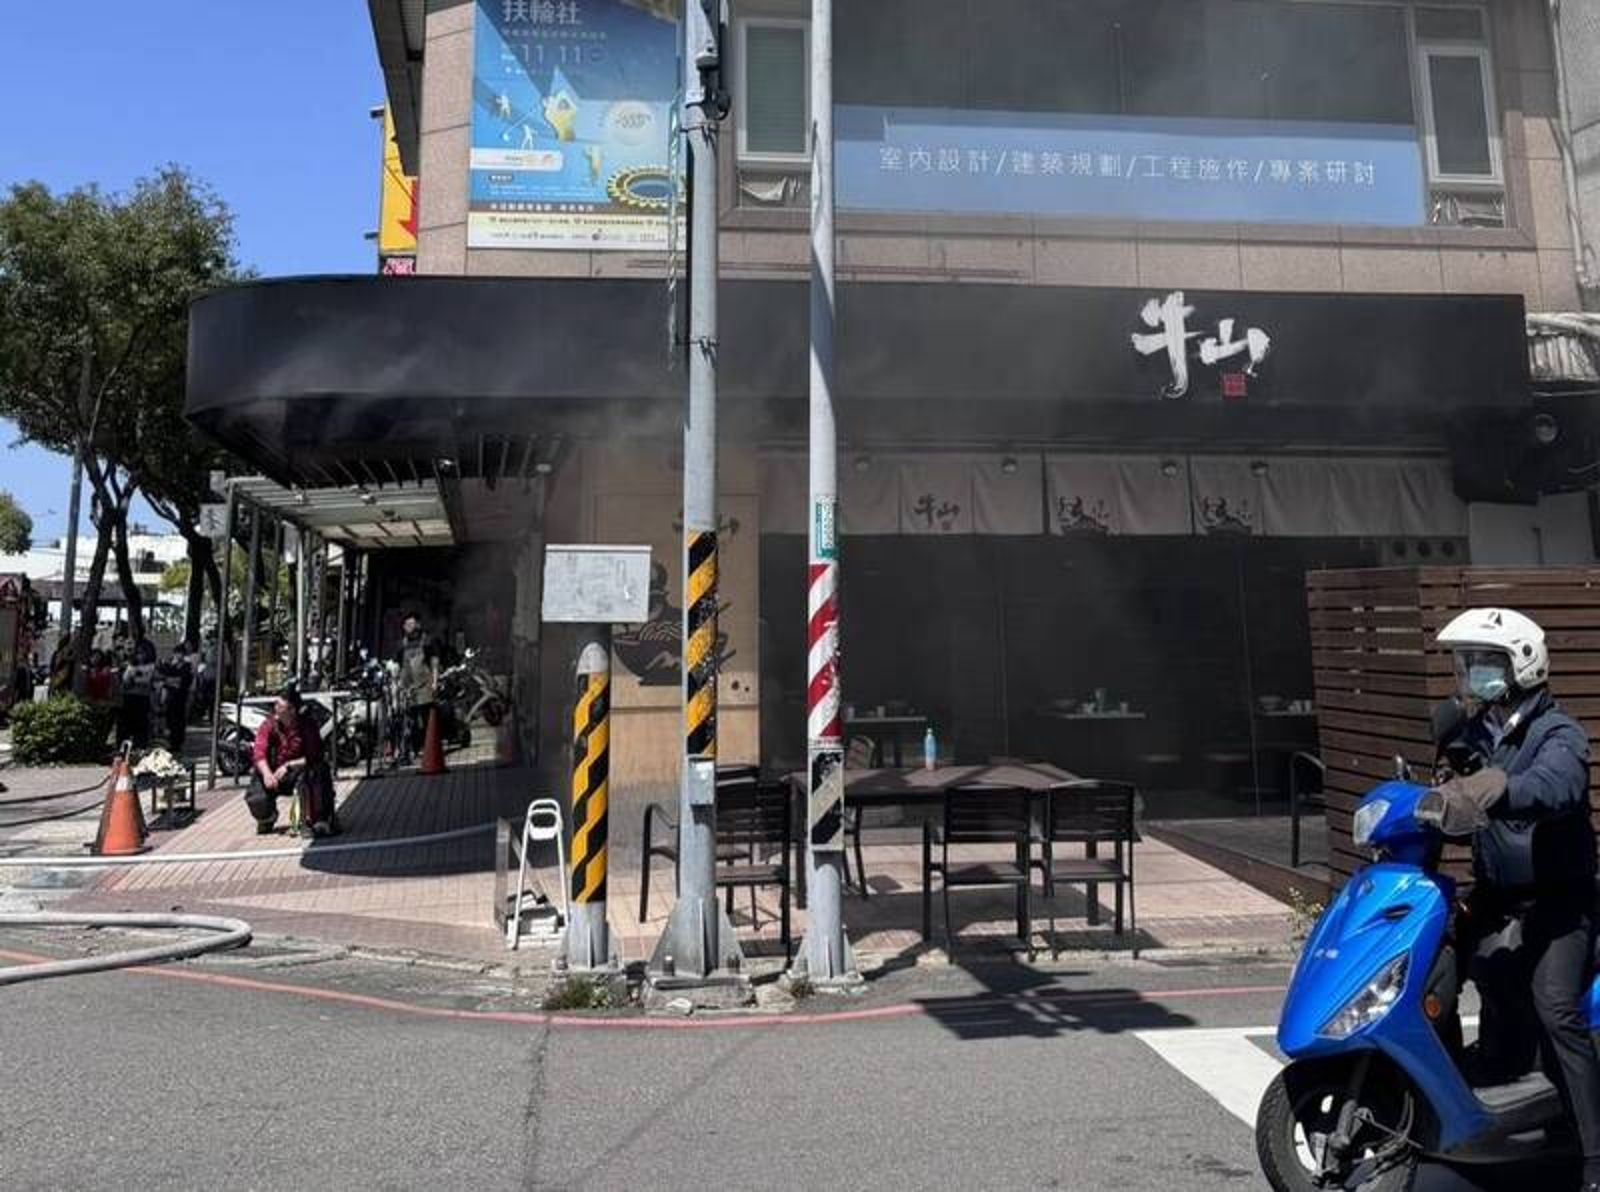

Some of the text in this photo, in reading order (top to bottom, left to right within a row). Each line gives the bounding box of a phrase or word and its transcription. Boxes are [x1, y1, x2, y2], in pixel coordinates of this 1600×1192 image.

[502, 0, 583, 25] 扶輪社
[1131, 290, 1271, 399] 牛山
